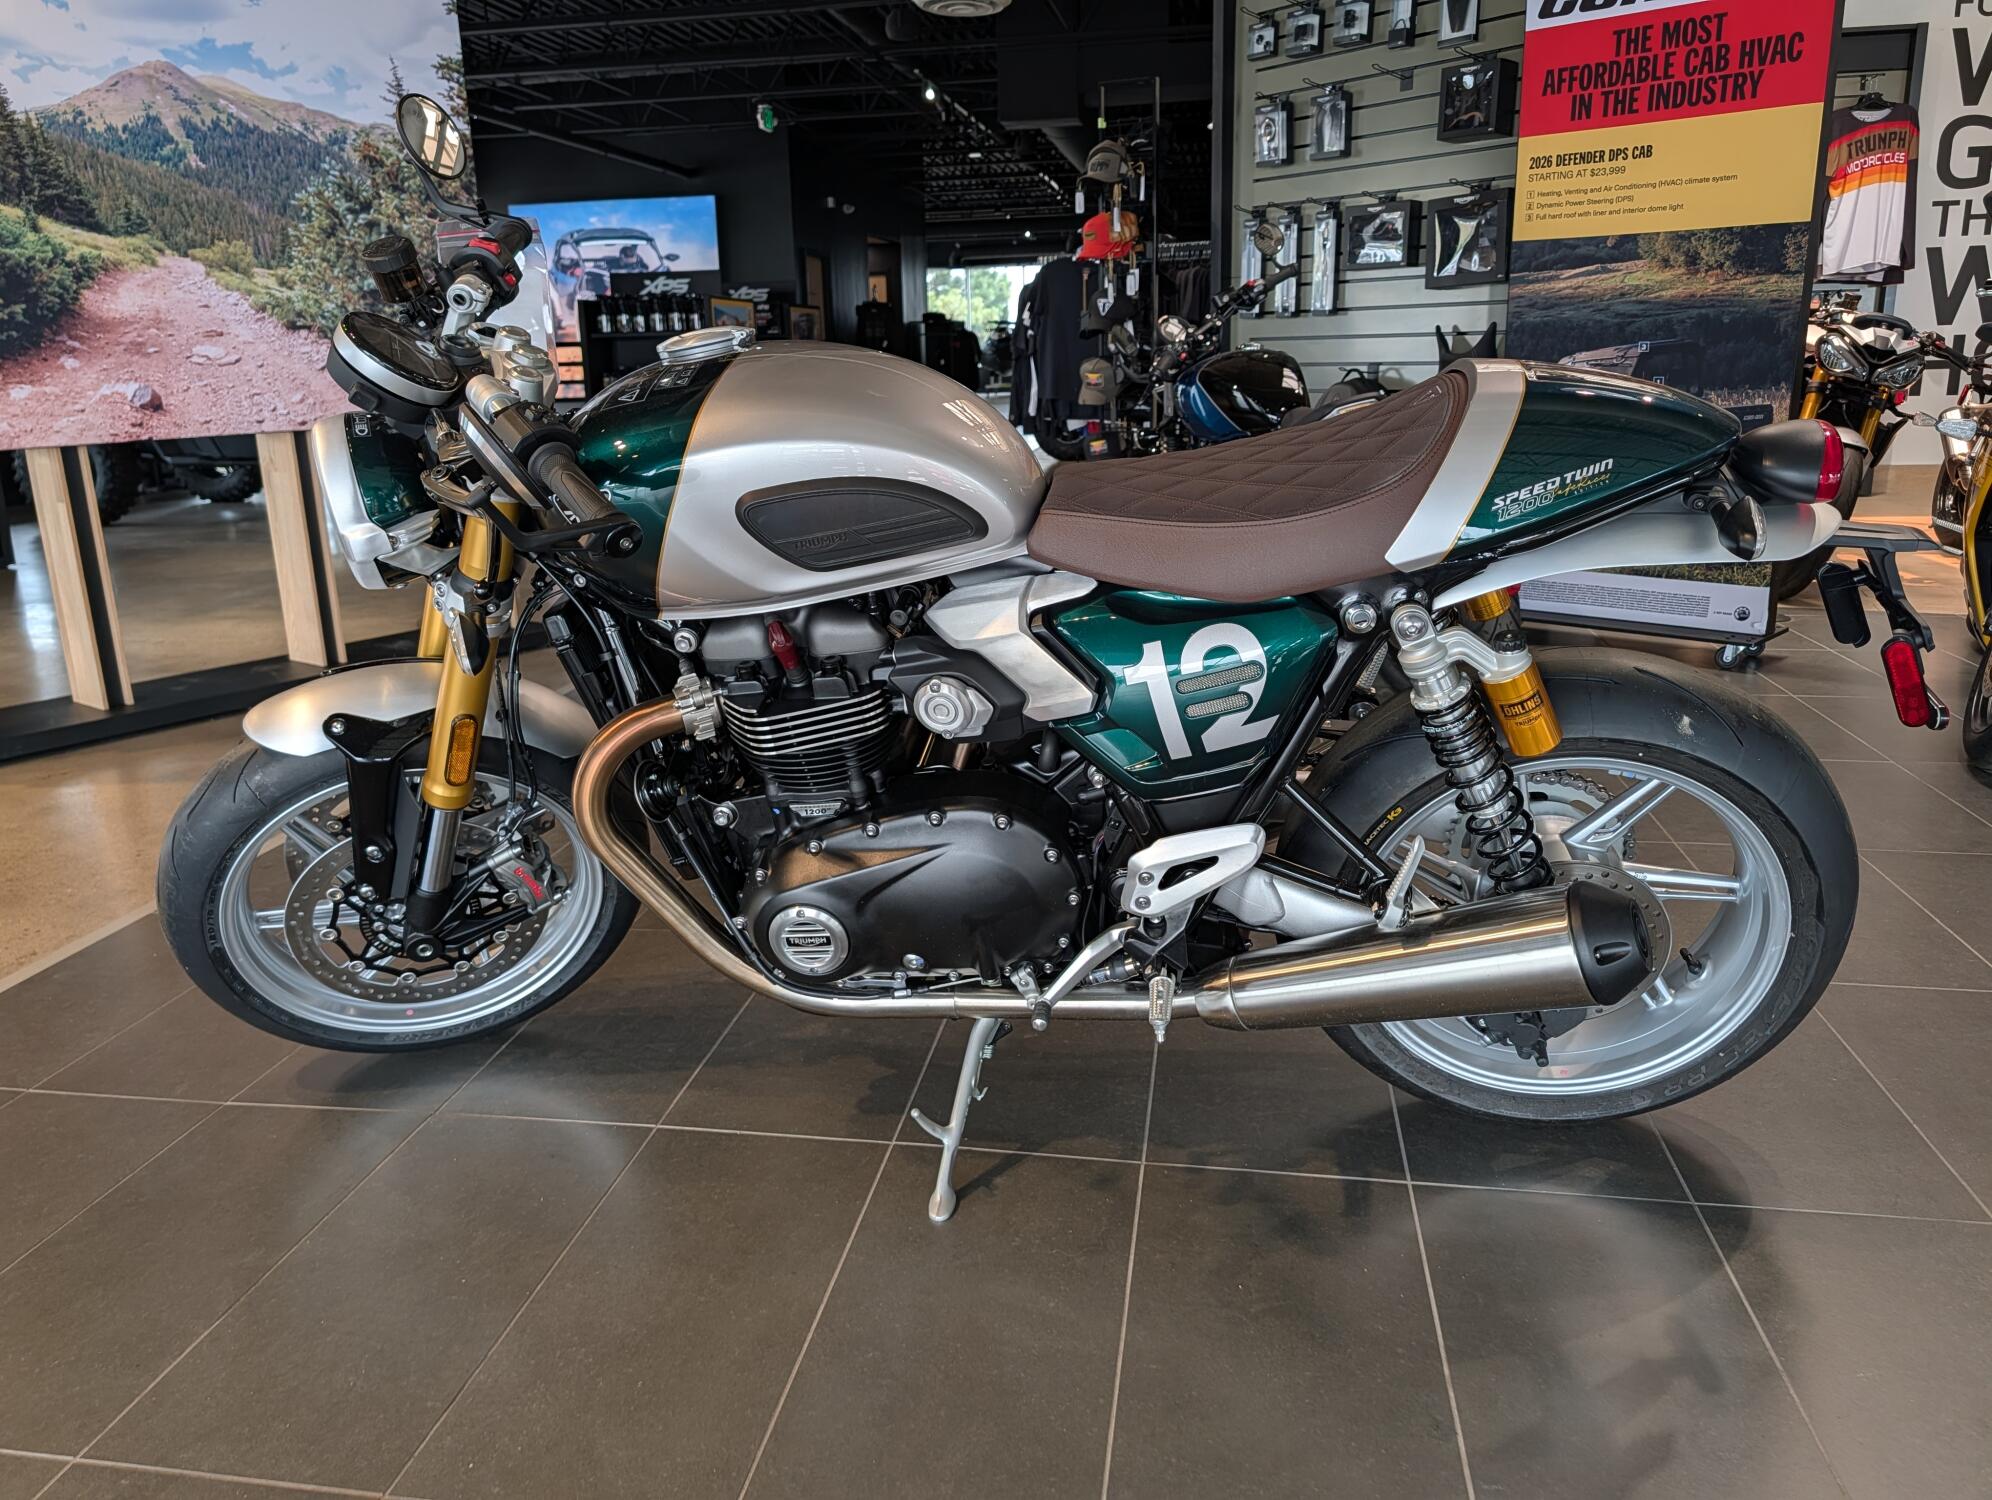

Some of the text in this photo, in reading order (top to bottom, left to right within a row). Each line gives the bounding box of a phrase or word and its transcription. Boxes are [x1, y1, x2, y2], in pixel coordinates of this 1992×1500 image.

[1613, 12, 1728, 57] THE MOST
[1541, 31, 1805, 96] AFFORDABLE CAB HVAC
[1570, 70, 1765, 121] IN THE INDUSTRY
[1529, 144, 1653, 170] 2026 DEFENDER DPS CAB
[1845, 152, 1906, 174] MOTORCCLES
[1528, 165, 1626, 183] STARTING AT $23,999
[1537, 190, 1562, 198] Heating,
[1564, 188, 1589, 196] Venting
[1614, 181, 1657, 191] Conditioning
[1658, 177, 1683, 188] (HVAC)
[1684, 176, 1710, 185] climate
[1712, 174, 1738, 183] system
[1537, 202, 1563, 210] Dynamic
[1565, 199, 1585, 207] Power
[1586, 196, 1615, 205] Steering
[1615, 195, 1634, 204] (DPS)
[1563, 211, 1577, 219] roof
[1593, 209, 1608, 217] liner
[1608, 207, 1621, 215] and
[1622, 206, 1647, 214] interior
[1647, 204, 1668, 212] dome
[1669, 203, 1684, 212] light
[1491, 458, 1614, 511] SPEED TWIN
[1498, 490, 1557, 522] 1200
[795, 531, 848, 550] TRIUMPH
[1123, 622, 1280, 761] 12
[1503, 694, 1542, 717] ÖHLINS
[1363, 818, 1391, 847] ACETEC
[788, 936, 828, 947] TRIUMPH
